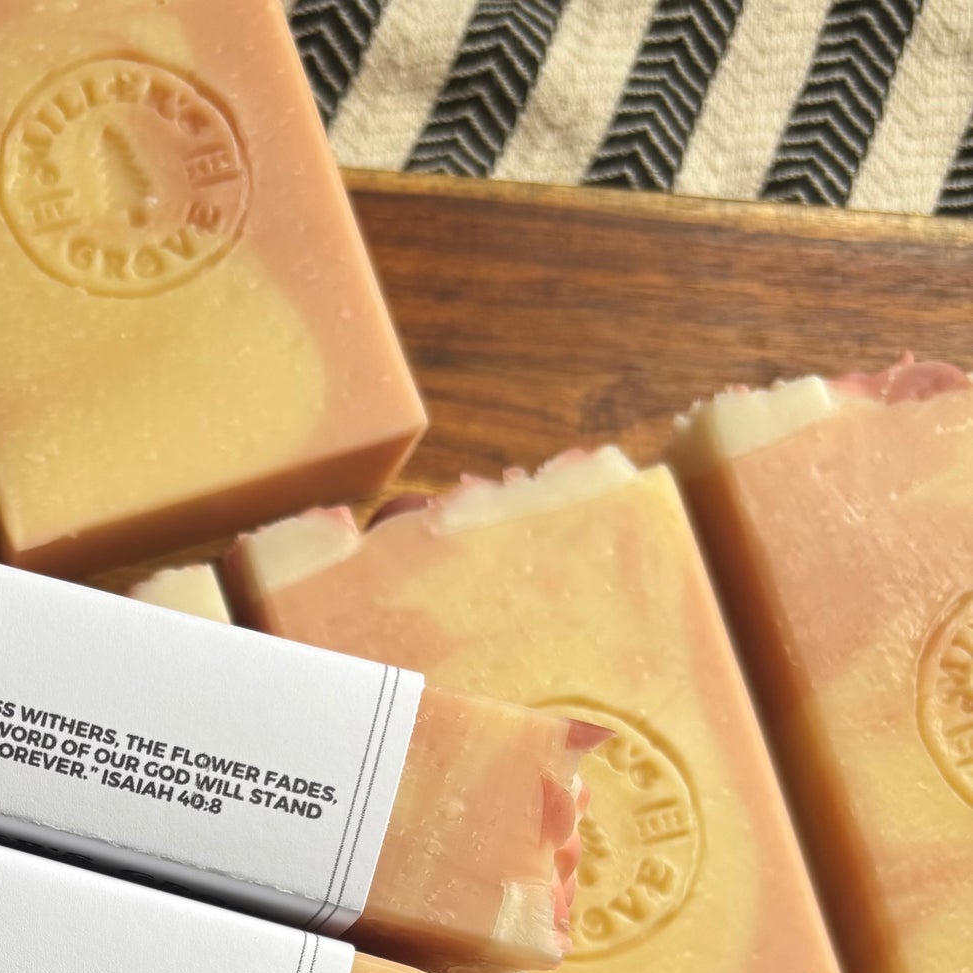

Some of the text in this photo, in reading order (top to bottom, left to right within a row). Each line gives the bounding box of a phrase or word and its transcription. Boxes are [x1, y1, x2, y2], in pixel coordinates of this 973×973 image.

[20, 704, 120, 749] WITHERS,
[125, 733, 168, 760] THE
[169, 745, 261, 784] FLOWER
[263, 770, 338, 806] FADES,
[61, 739, 92, 759] OF
[93, 747, 140, 774] OUR
[143, 761, 191, 786] GOD
[195, 772, 245, 802] WILL
[248, 787, 323, 820] STAND
[100, 768, 175, 803] ISAIAH
[176, 789, 223, 815] 40:8
[571, 856, 674, 941] OVE
